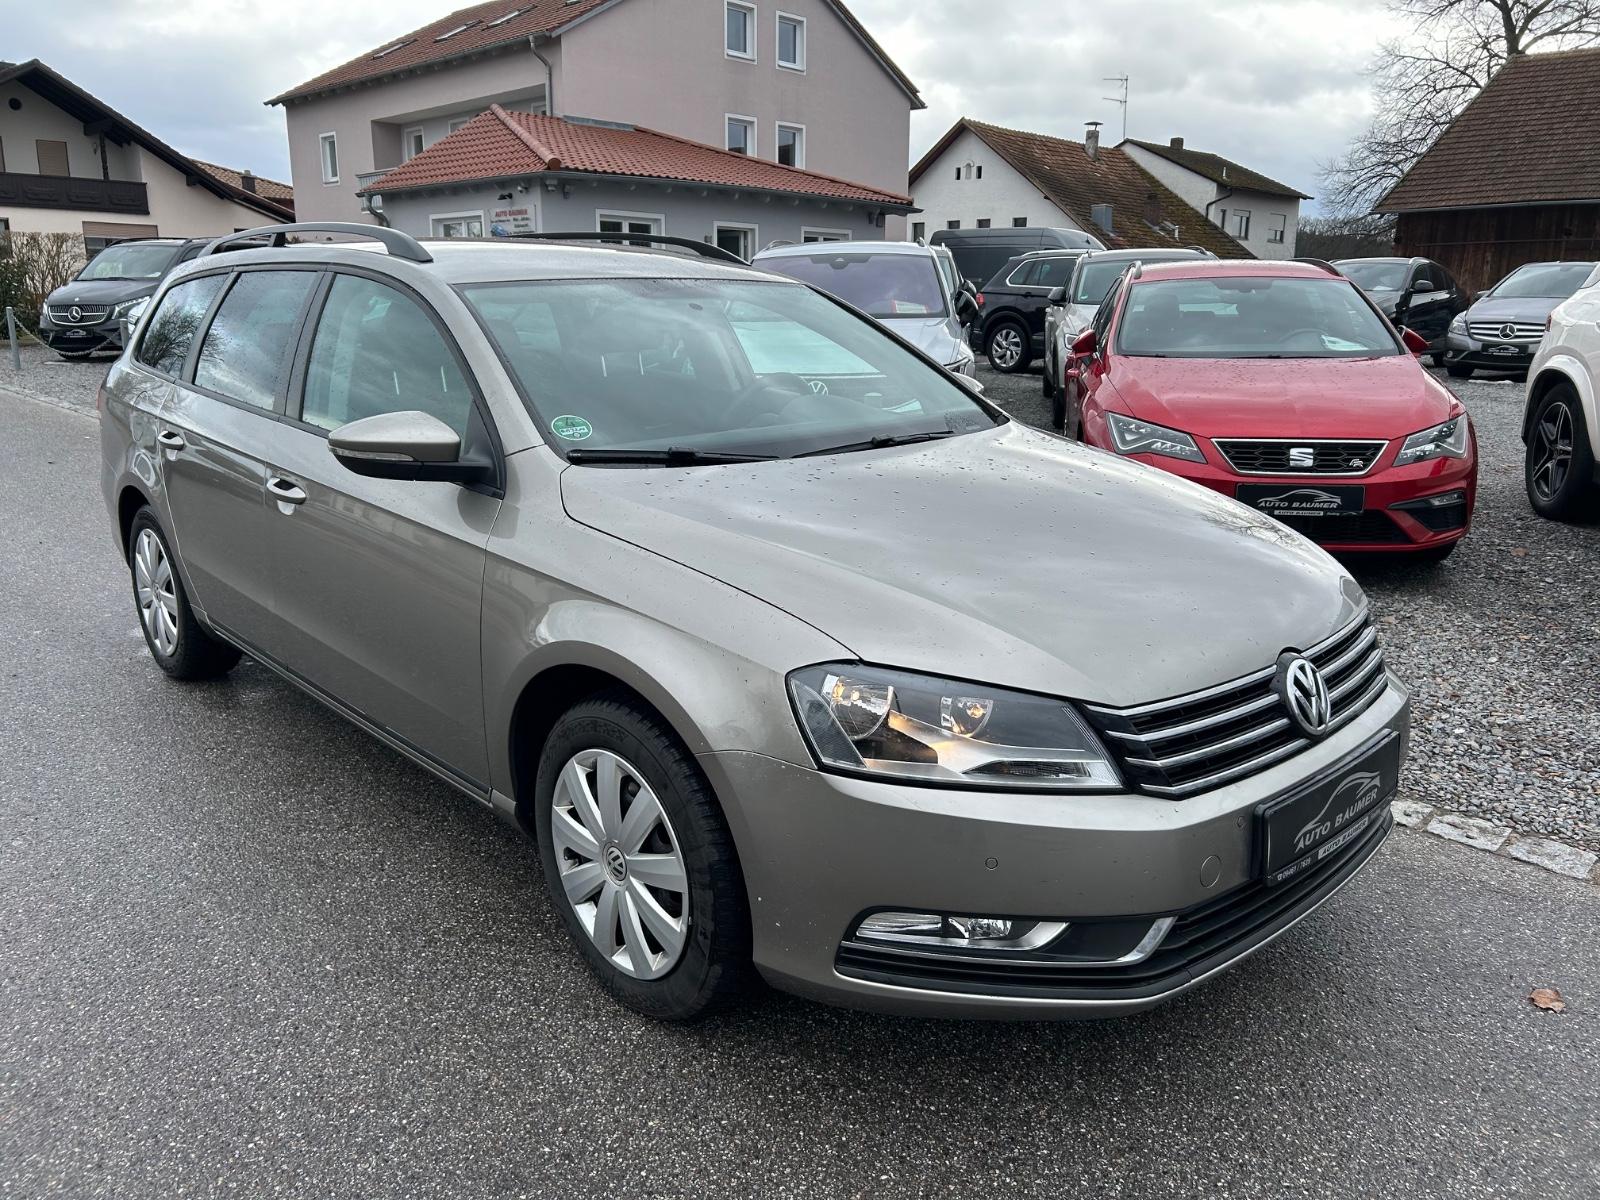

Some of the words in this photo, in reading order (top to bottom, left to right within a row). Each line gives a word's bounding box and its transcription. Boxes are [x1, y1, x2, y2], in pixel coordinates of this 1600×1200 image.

[1291, 501, 1338, 509] BAUMER
[1286, 658, 1331, 735] VW
[1295, 821, 1331, 853] AUTO
[1334, 788, 1378, 828] BAUMER
